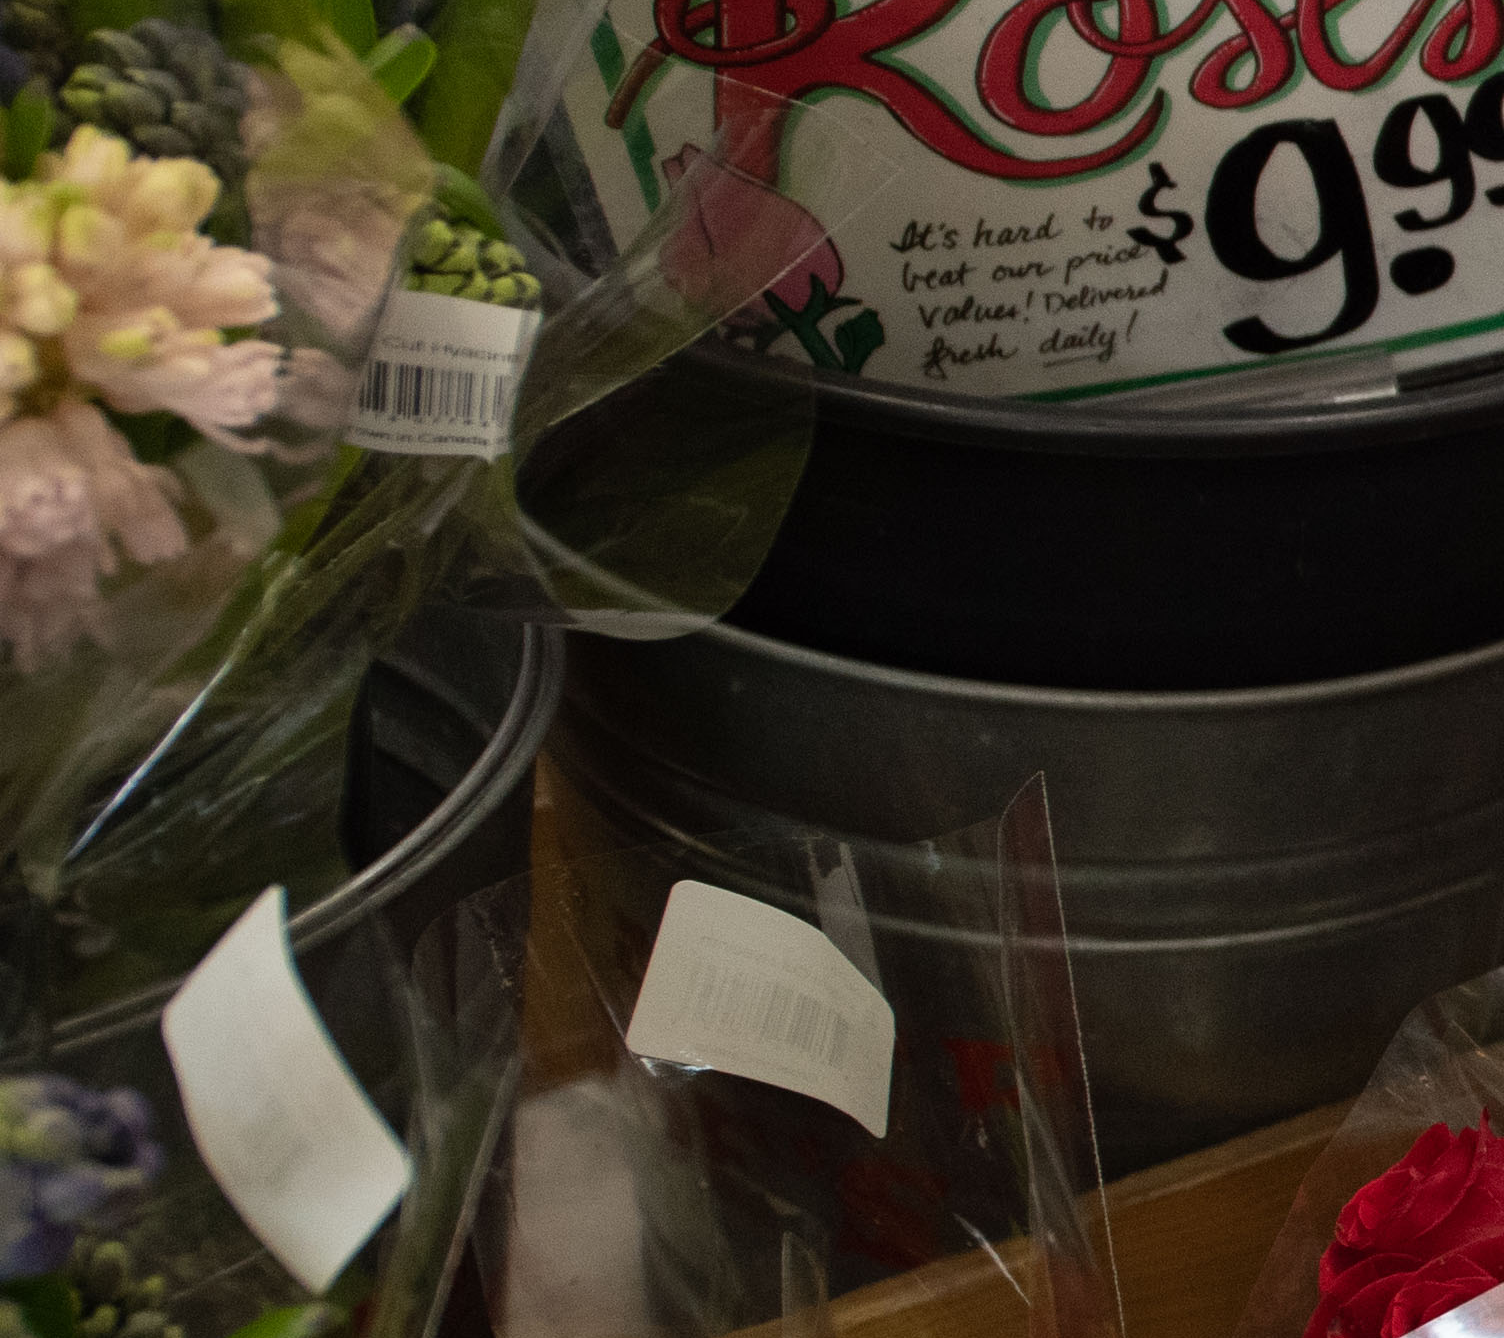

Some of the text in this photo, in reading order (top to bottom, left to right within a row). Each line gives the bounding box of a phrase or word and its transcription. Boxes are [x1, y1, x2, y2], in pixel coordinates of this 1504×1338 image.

[889, 202, 1115, 257] It's hard to
[900, 241, 1148, 298] beat our price
[917, 269, 1170, 332] values! Delivered
[920, 310, 1139, 381] fresh daily!
